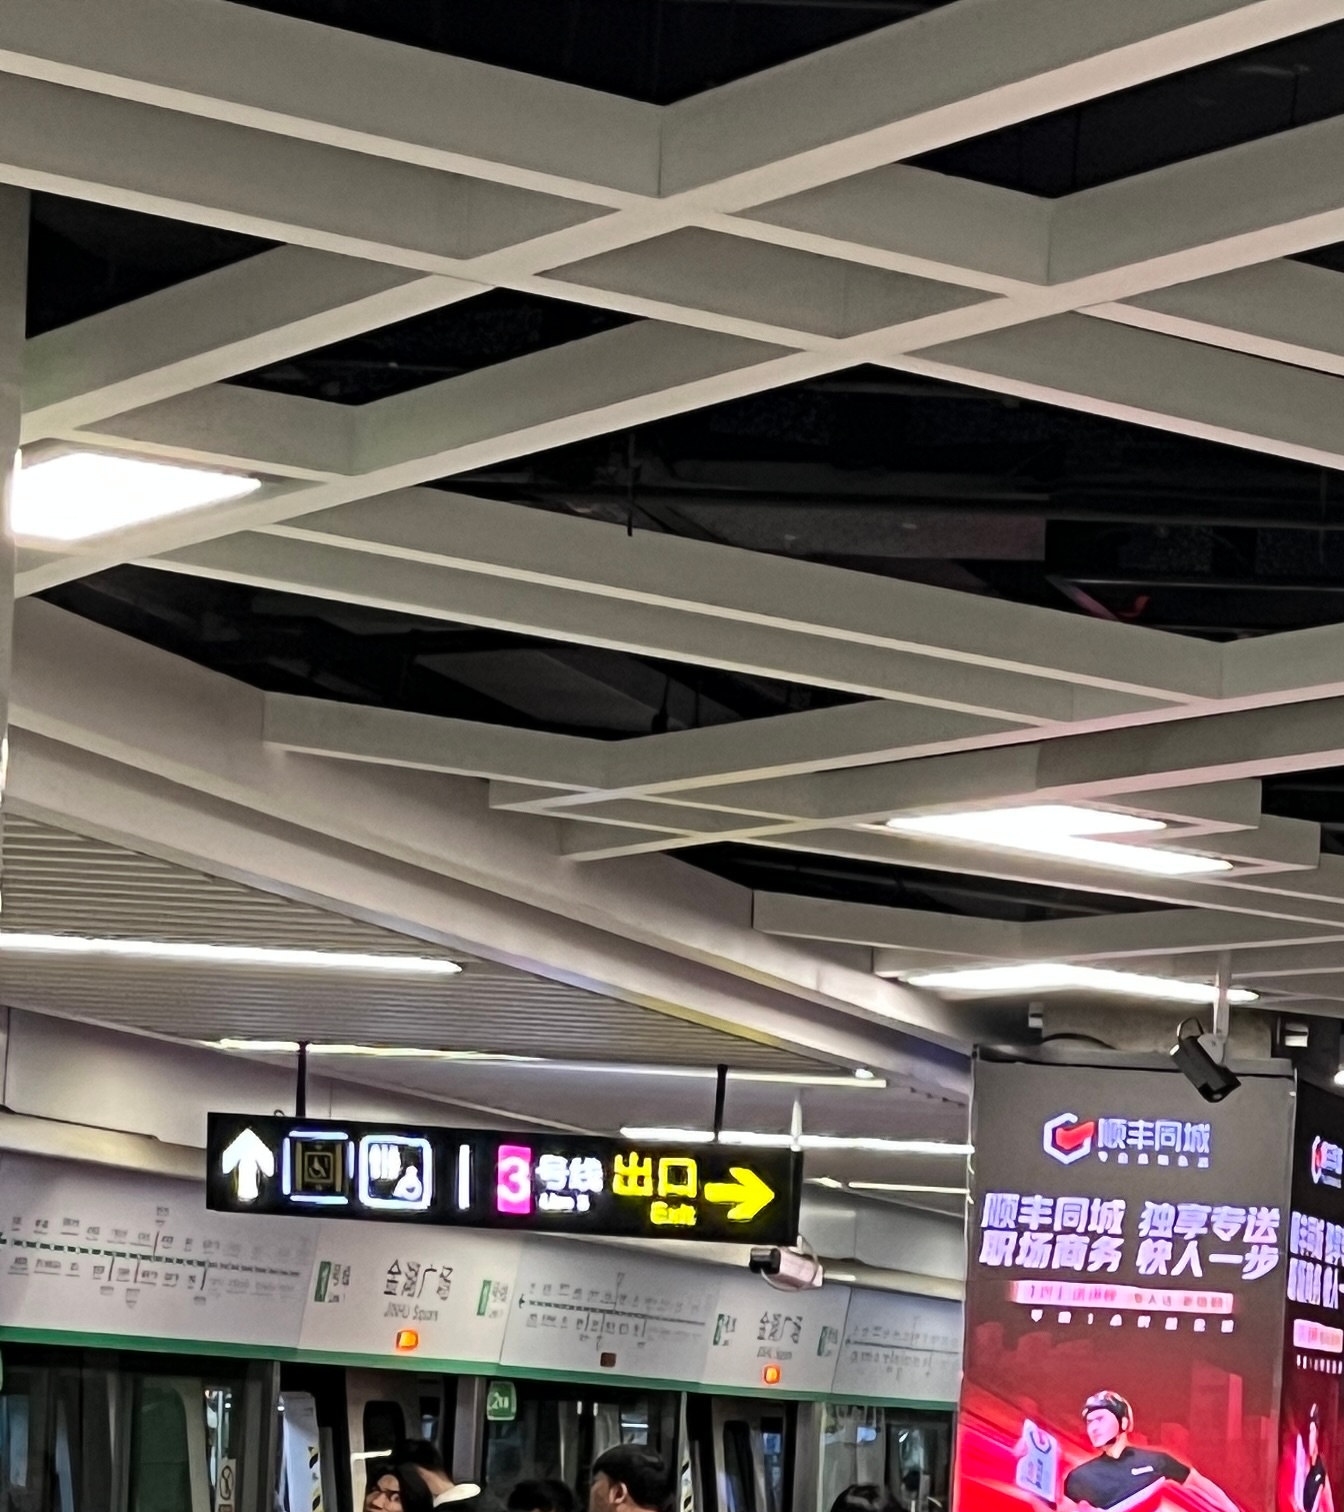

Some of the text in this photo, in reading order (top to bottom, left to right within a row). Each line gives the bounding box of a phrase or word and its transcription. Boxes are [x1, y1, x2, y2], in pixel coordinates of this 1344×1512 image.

[1098, 1118, 1210, 1153] 顺丰同城
[613, 1152, 697, 1198] 出口
[981, 1193, 1281, 1243] 顺丰同城 独享专送
[1136, 1238, 1280, 1280] 快人一步
